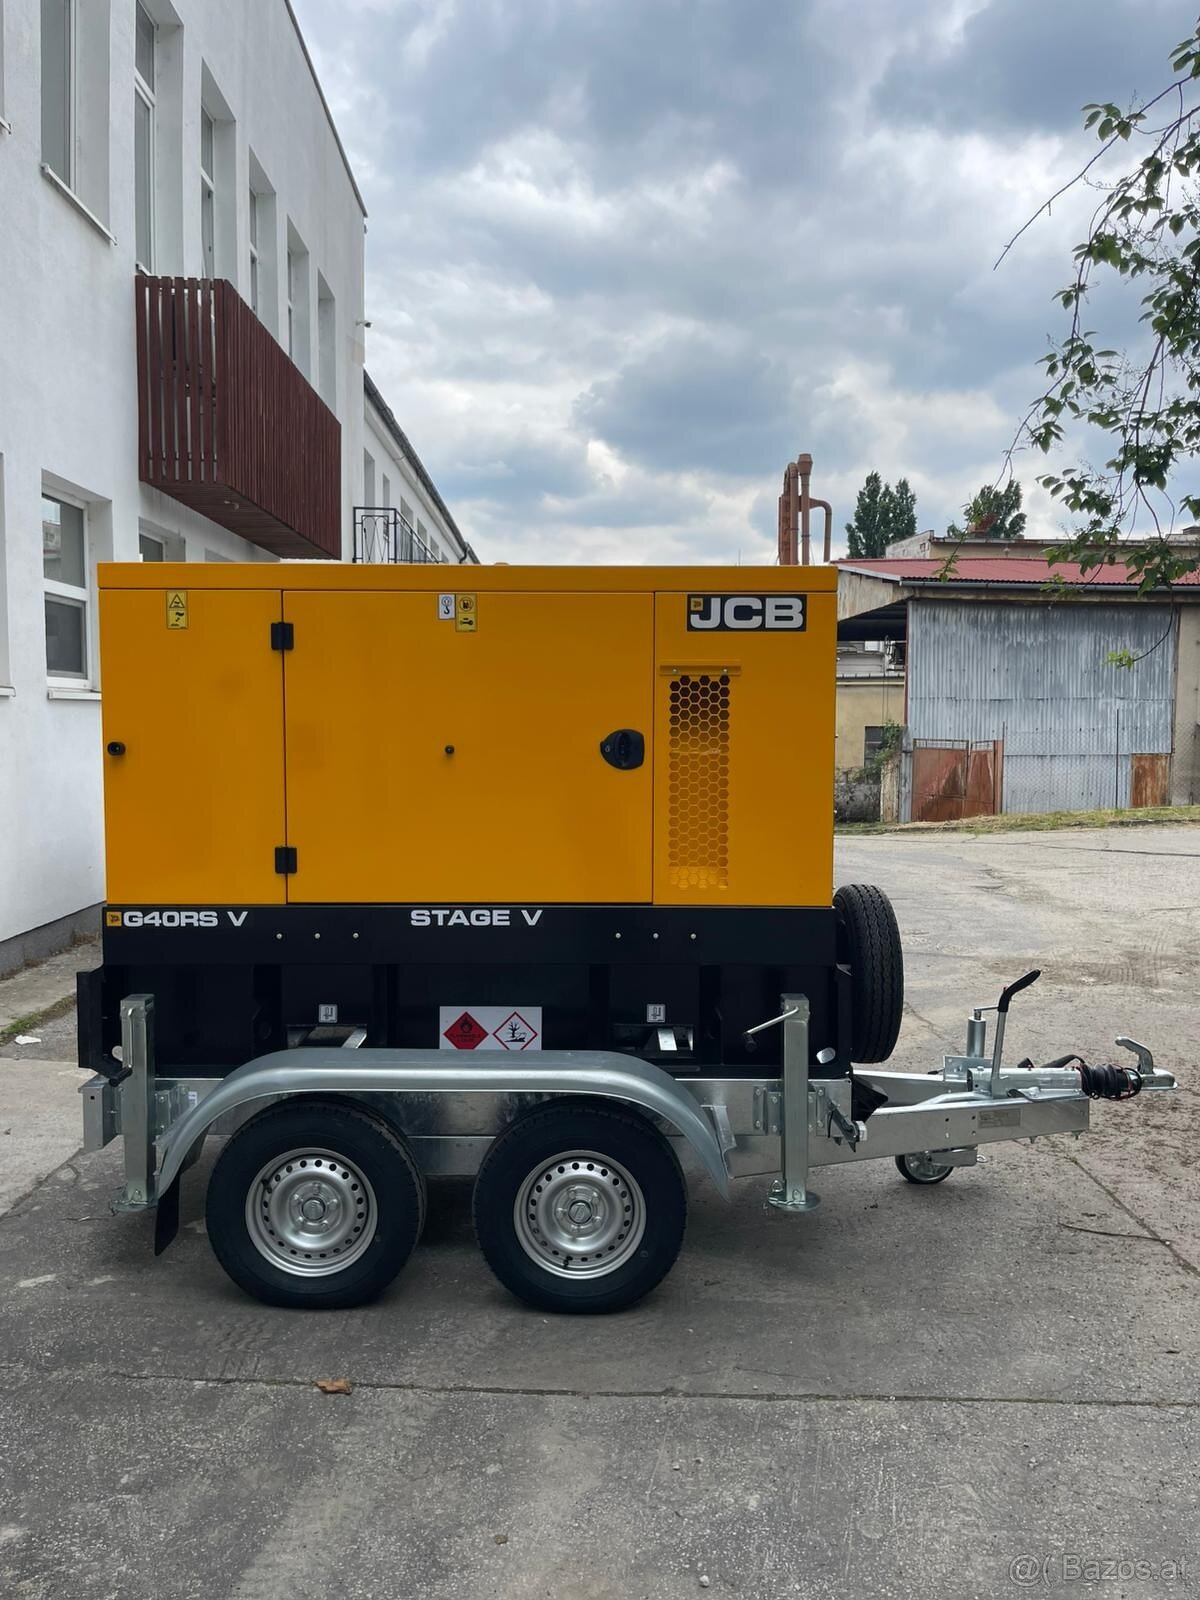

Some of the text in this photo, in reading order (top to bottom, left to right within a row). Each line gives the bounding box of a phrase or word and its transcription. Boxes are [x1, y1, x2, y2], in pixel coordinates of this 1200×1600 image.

[690, 597, 804, 629] JCB
[123, 911, 249, 927] G40RS V
[410, 909, 543, 926] STAGE V
